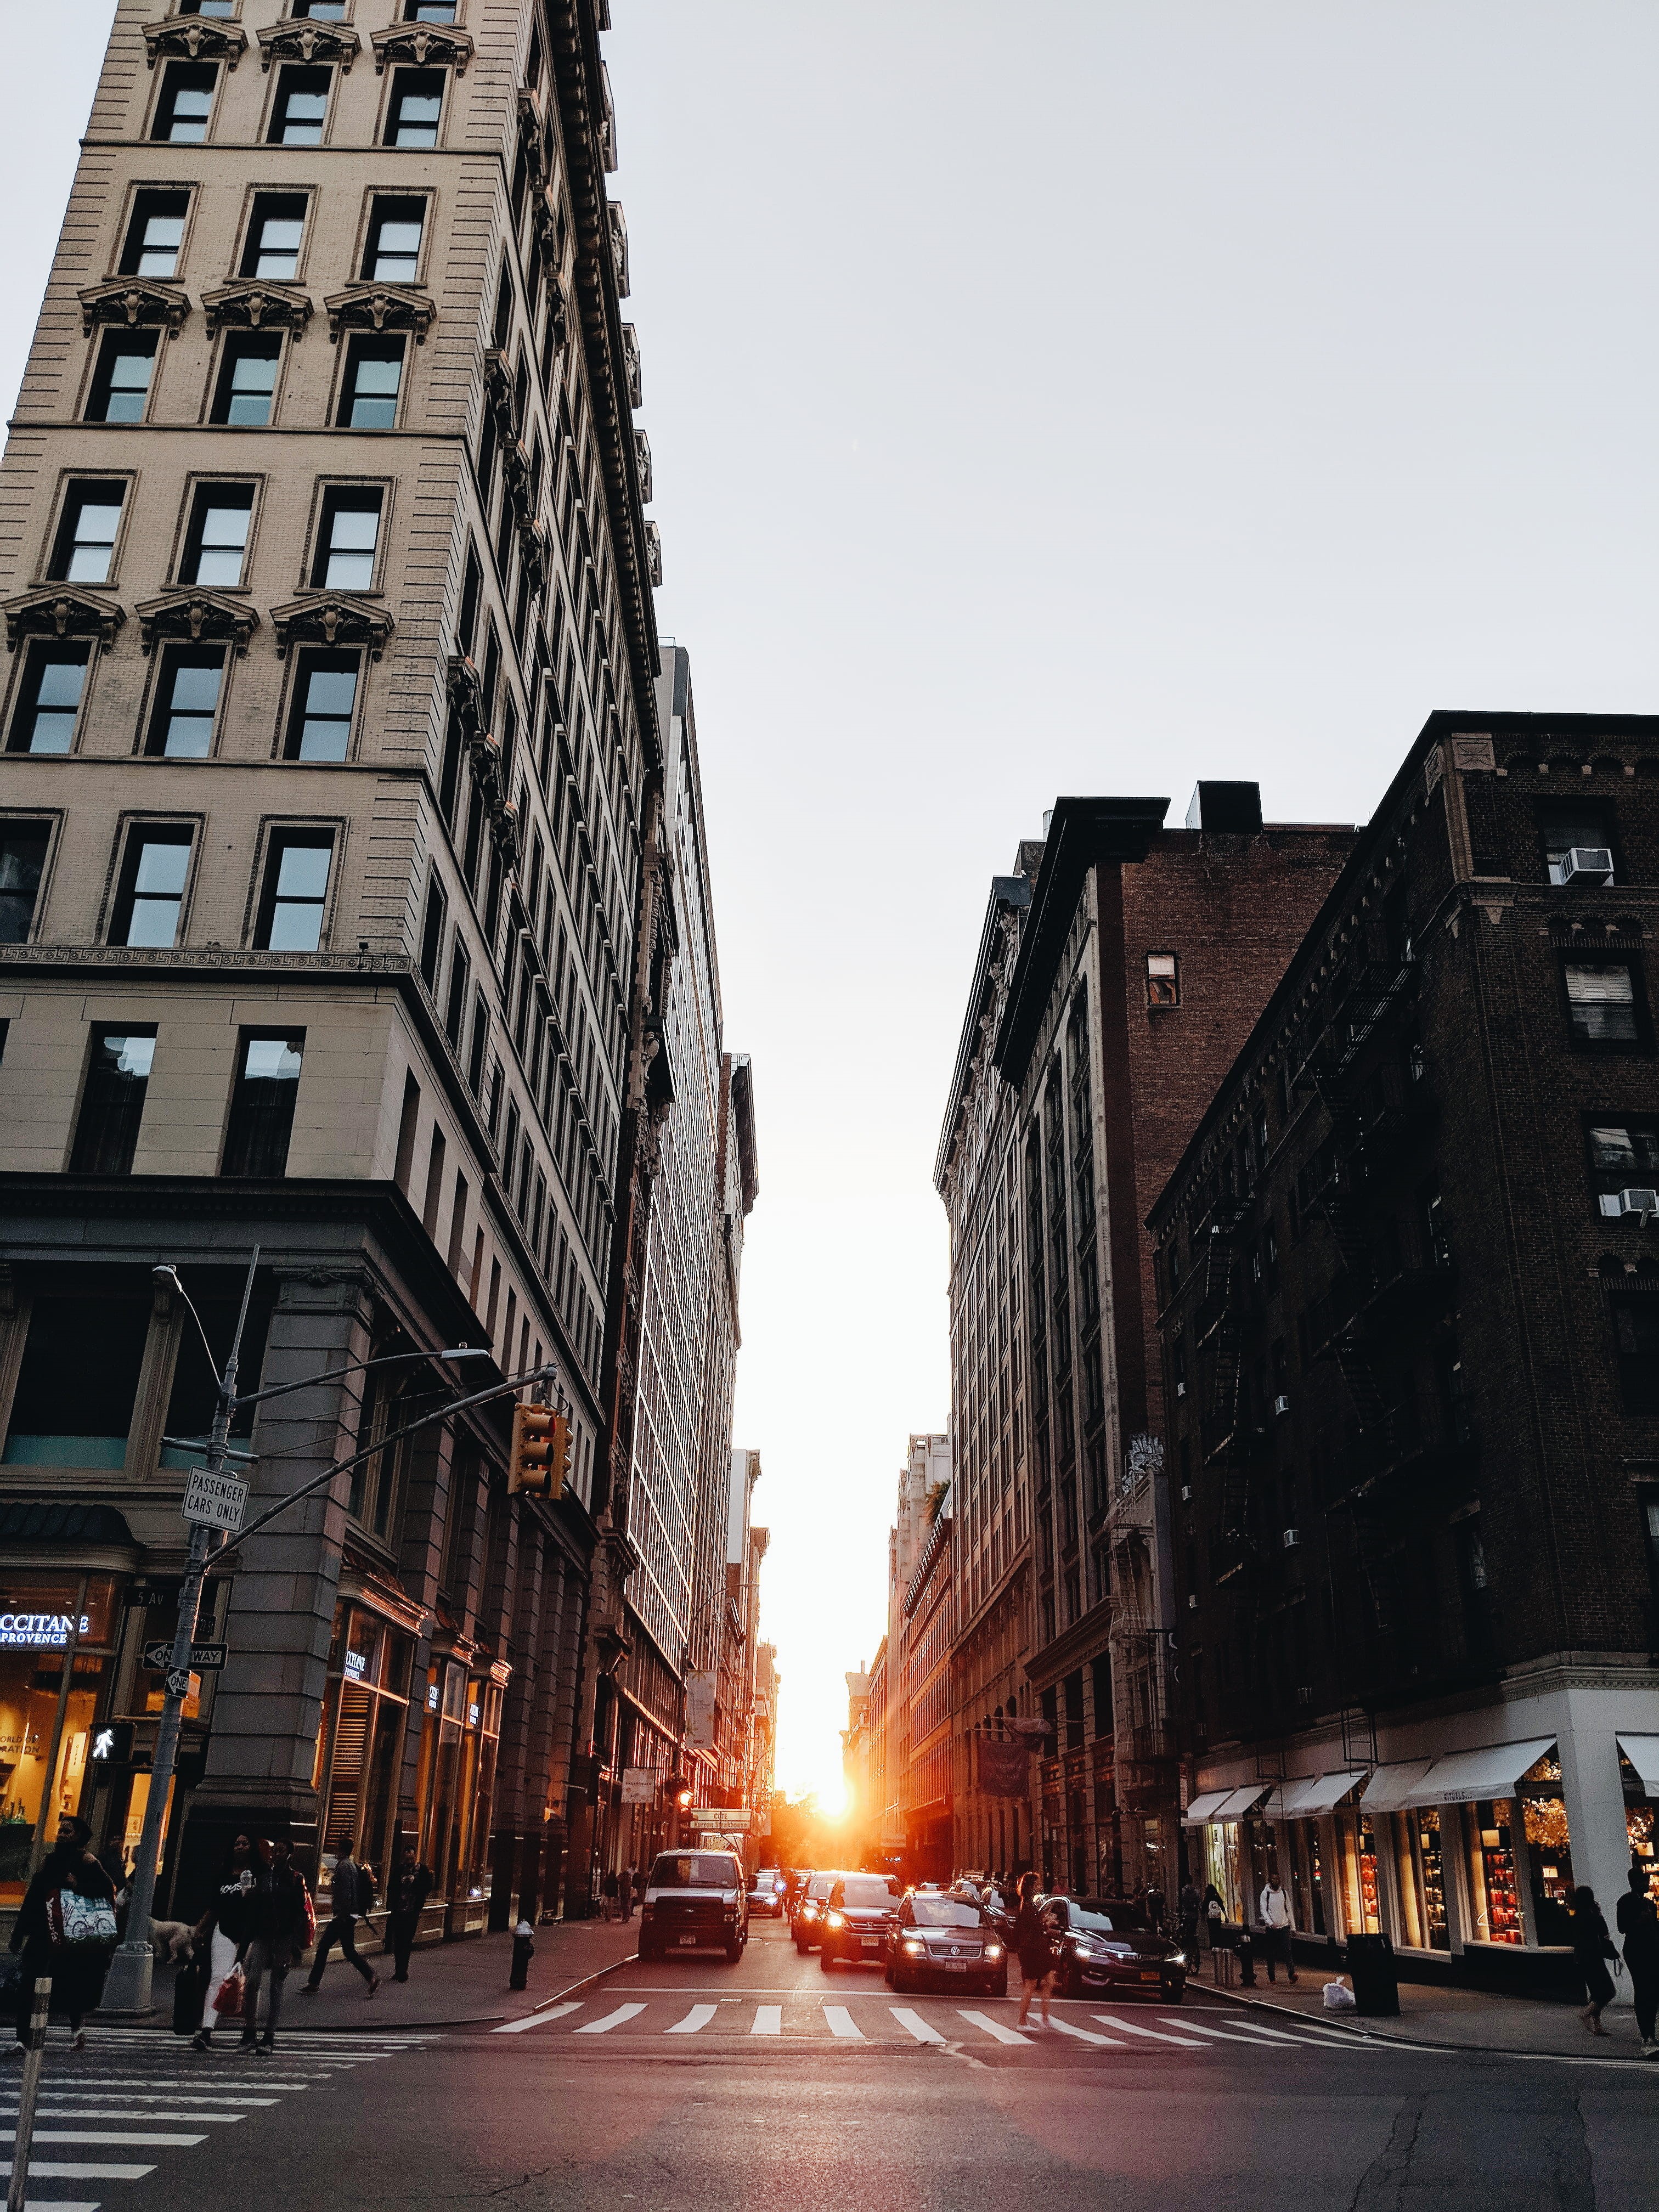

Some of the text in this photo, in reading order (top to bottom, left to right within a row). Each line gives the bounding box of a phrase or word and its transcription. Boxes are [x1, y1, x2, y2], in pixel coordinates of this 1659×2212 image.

[192, 1474, 244, 1503] PASSENGER
[188, 1494, 240, 1522] CARS ONLY
[137, 1592, 144, 1604] 5
[0, 1614, 89, 1633] CCITANE
[1, 1633, 67, 1644] PROVENCE
[155, 1650, 218, 1662] ON WAY
[171, 1675, 187, 1689] ONE
[0, 1745, 40, 1753] RATON
